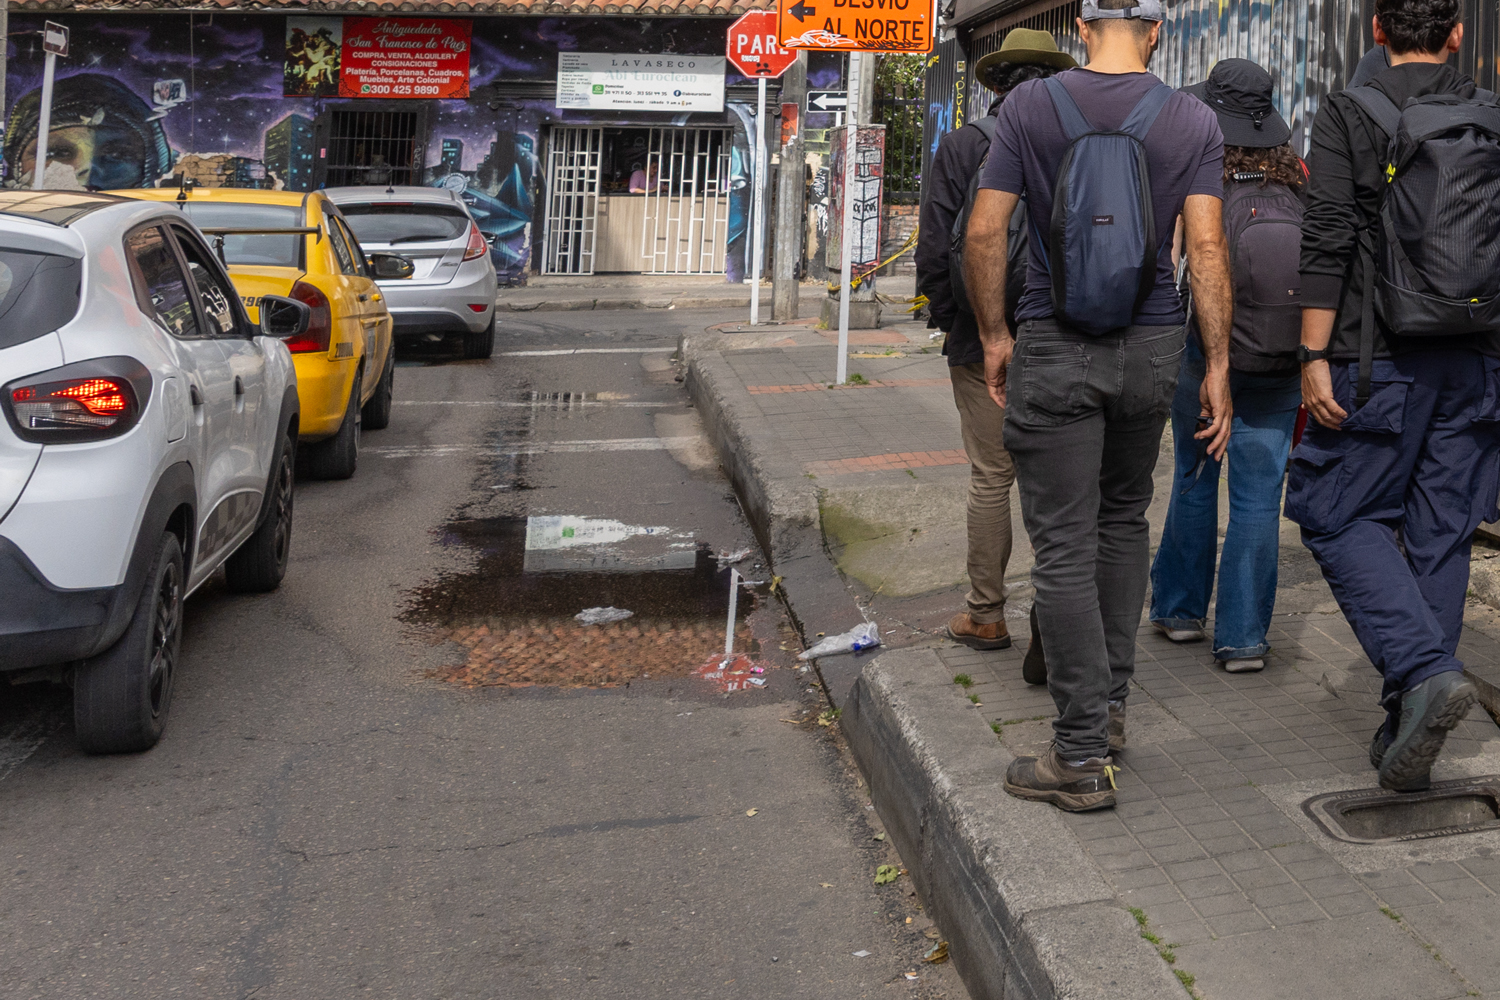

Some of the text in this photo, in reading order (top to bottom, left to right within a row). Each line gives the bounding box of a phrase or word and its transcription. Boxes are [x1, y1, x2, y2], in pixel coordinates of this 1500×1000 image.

[822, 17, 848, 38] AL
[855, 18, 924, 41] NORTE
[346, 34, 372, 48] San
[376, 35, 423, 49] Francisco
[425, 37, 438, 48] de
[737, 34, 789, 55] PAR
[611, 59, 696, 69] LAVASECO
[345, 68, 379, 76] Platería,
[380, 69, 426, 77] Porcelanas,
[631, 70, 697, 83] Euroclean
[416, 76, 450, 84] Colonial
[371, 85, 439, 95] 300 425 9890
